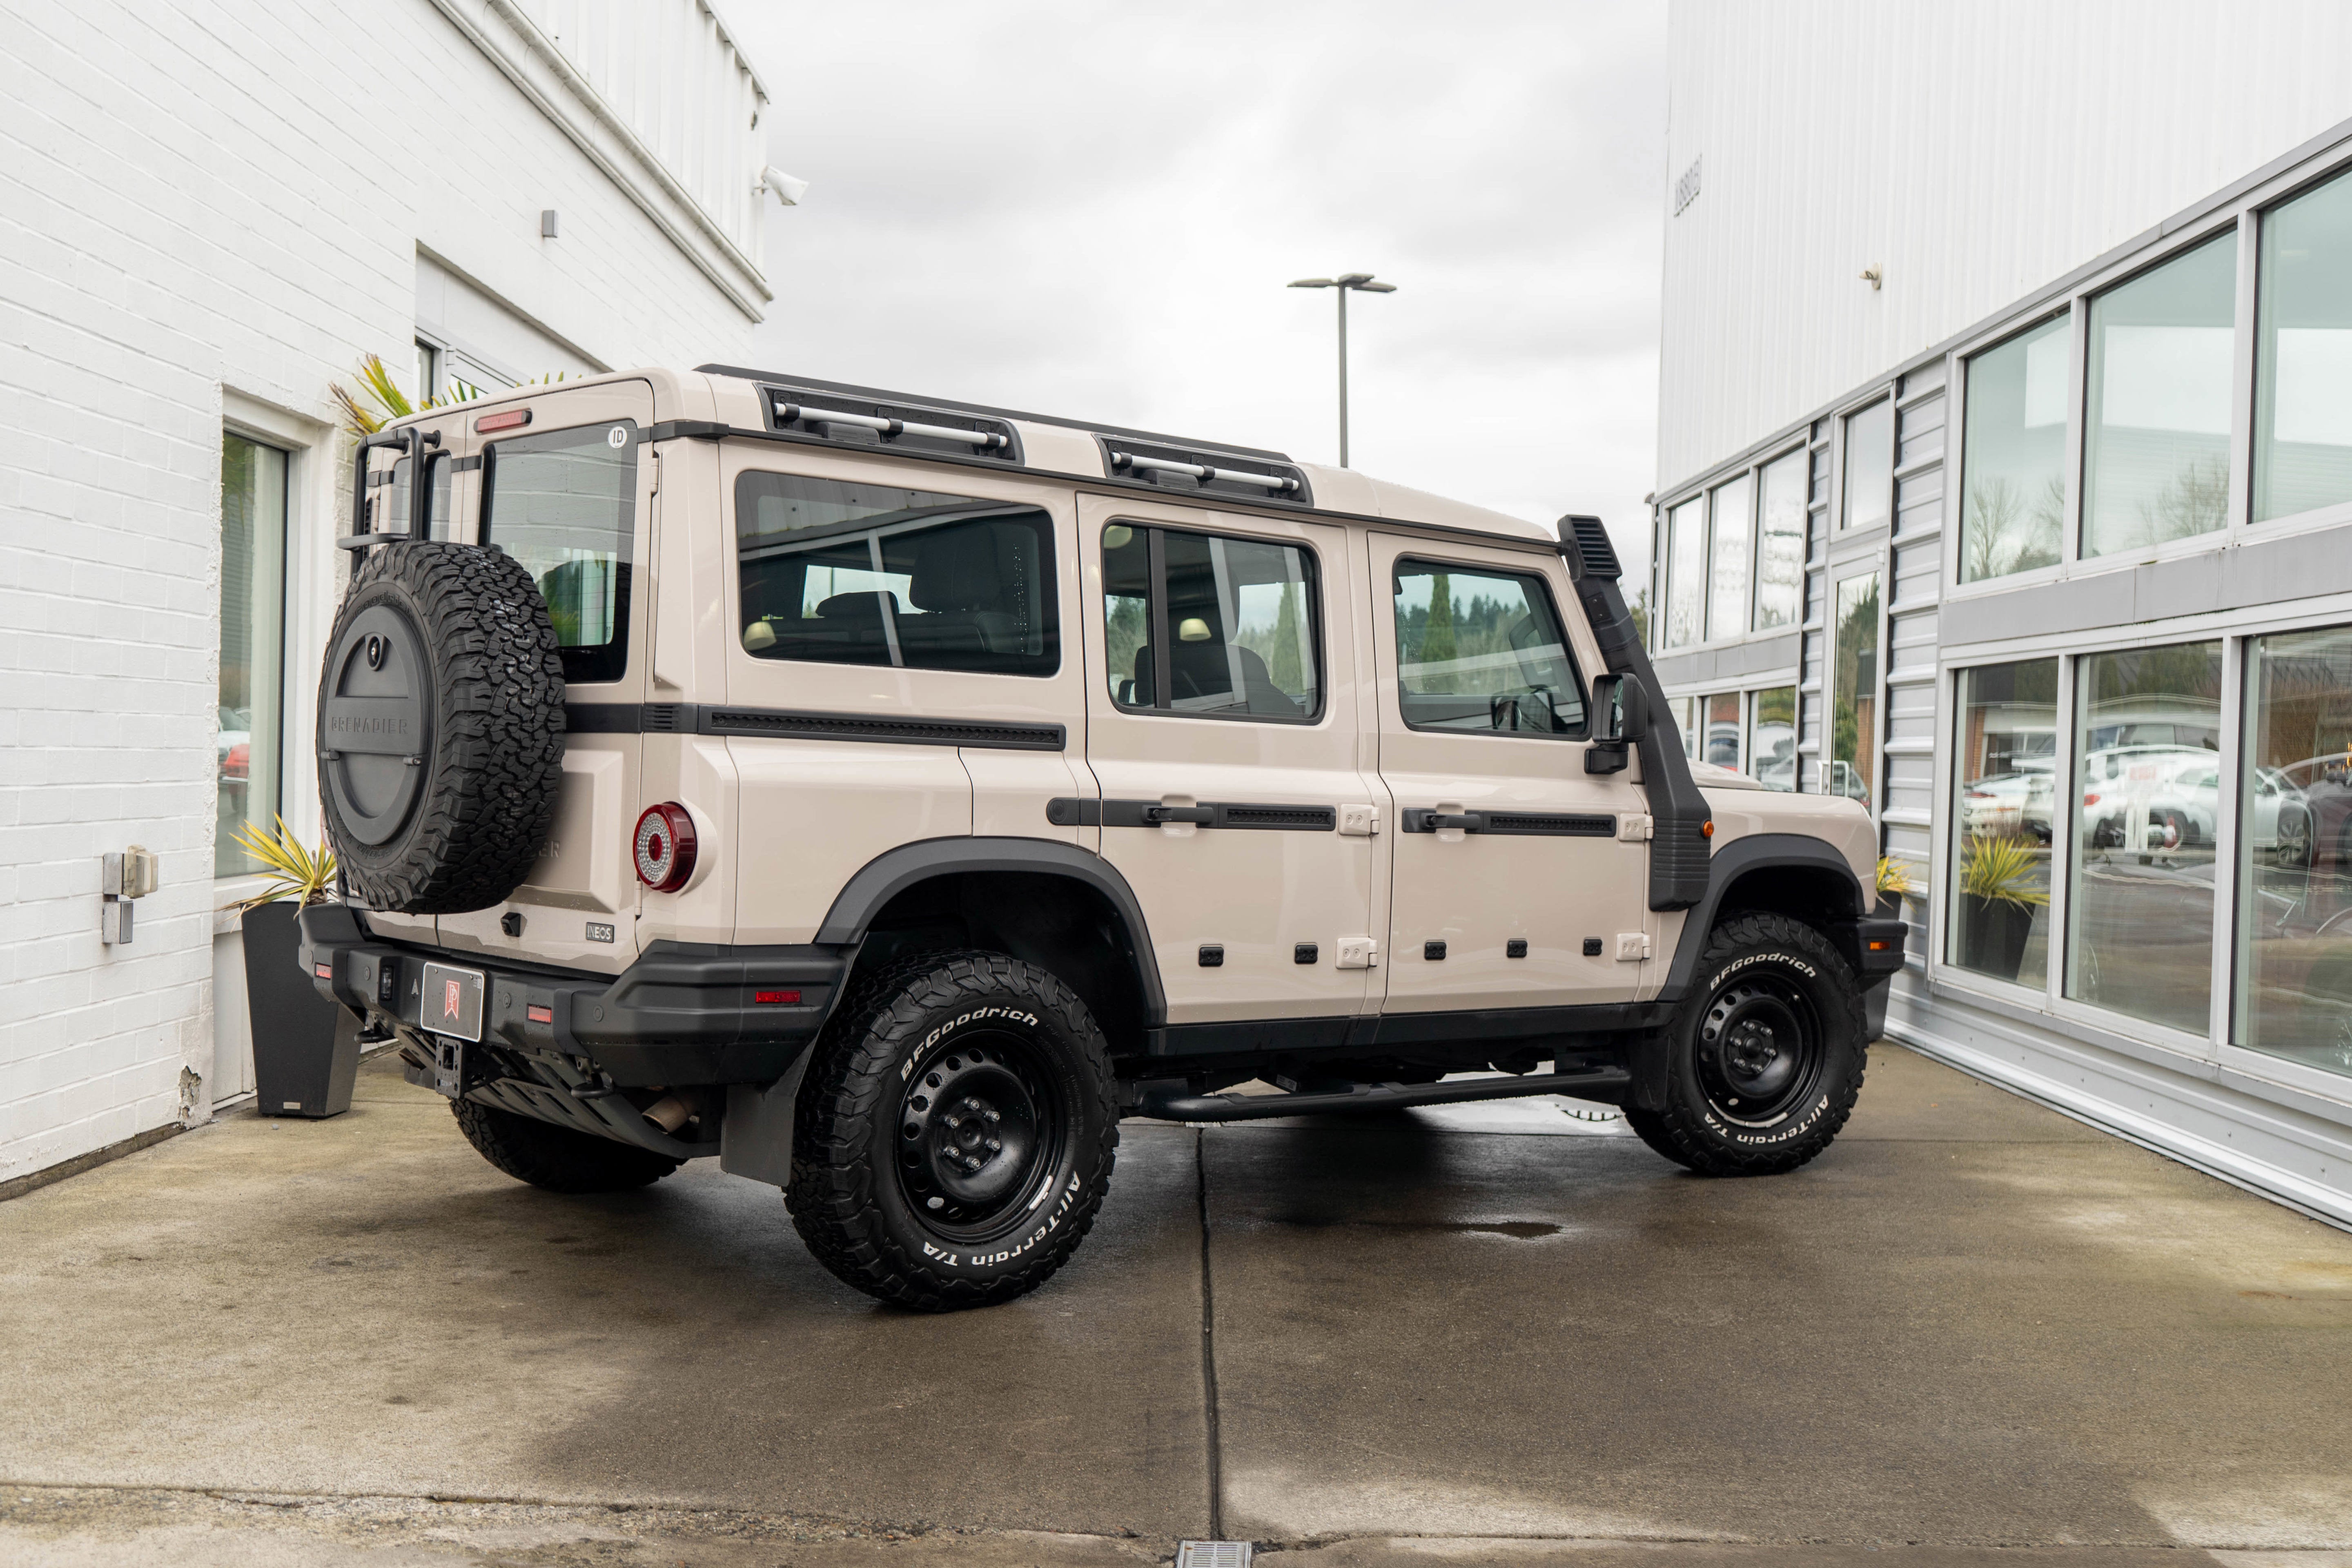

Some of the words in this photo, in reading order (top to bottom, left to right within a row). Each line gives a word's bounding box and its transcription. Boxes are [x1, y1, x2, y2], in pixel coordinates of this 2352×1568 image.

[613, 430, 624, 443] ID
[331, 717, 408, 734] GRENADIER
[587, 925, 611, 940] INEOS
[1710, 952, 1816, 991] BFGoodrich
[900, 1007, 1039, 1082] BFGoodrich
[1704, 1112, 1728, 1138] T/A
[1737, 1094, 1829, 1144] All-Terrain
[971, 1171, 1081, 1266] All-Terrain
[923, 1241, 958, 1266] T/A
